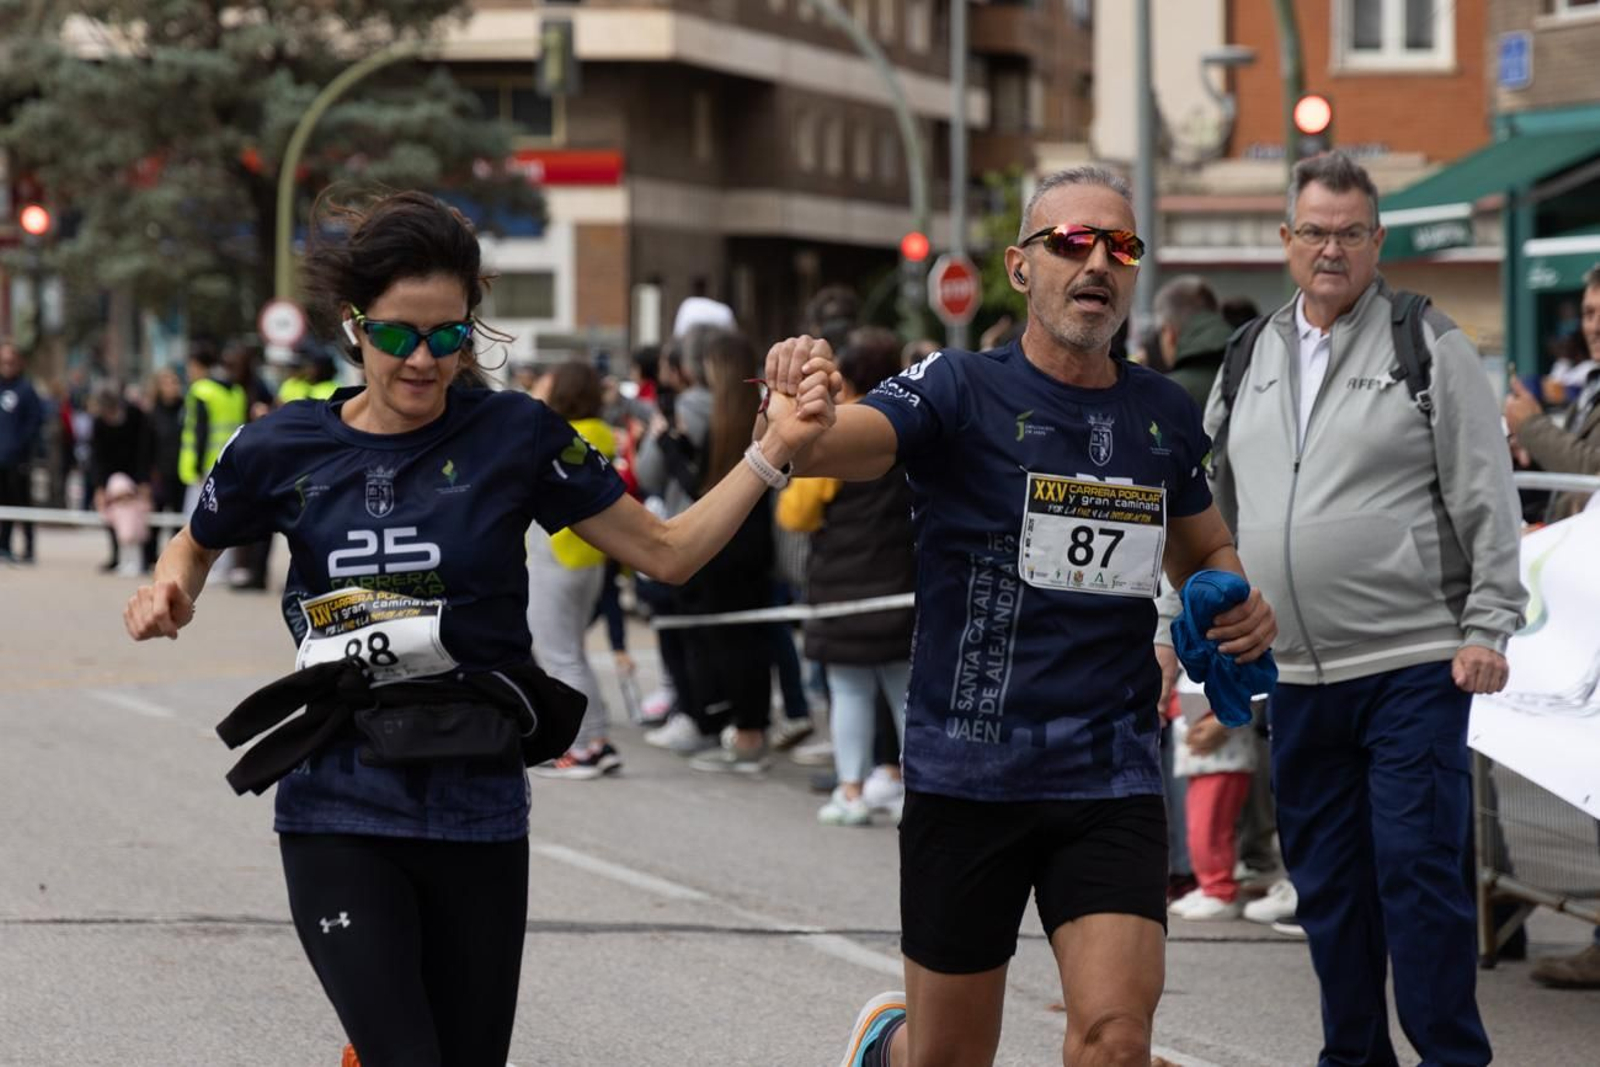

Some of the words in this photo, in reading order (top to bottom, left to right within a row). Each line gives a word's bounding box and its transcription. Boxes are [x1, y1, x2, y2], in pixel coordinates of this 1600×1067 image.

[1034, 479, 1068, 503] XXV
[1069, 484, 1117, 499] CARRERA
[1118, 489, 1161, 503] POPULAR
[1081, 495, 1111, 507] gran
[1114, 498, 1161, 512] caminata
[327, 526, 441, 578] 25
[1067, 525, 1125, 569] 87
[309, 602, 333, 628] XXV
[341, 602, 366, 620] gran
[967, 556, 995, 644] CATALINA
[985, 563, 1016, 683] ALEJANDRA
[344, 631, 399, 669] 88
[957, 650, 981, 711] SANTA
[979, 687, 999, 714] DE
